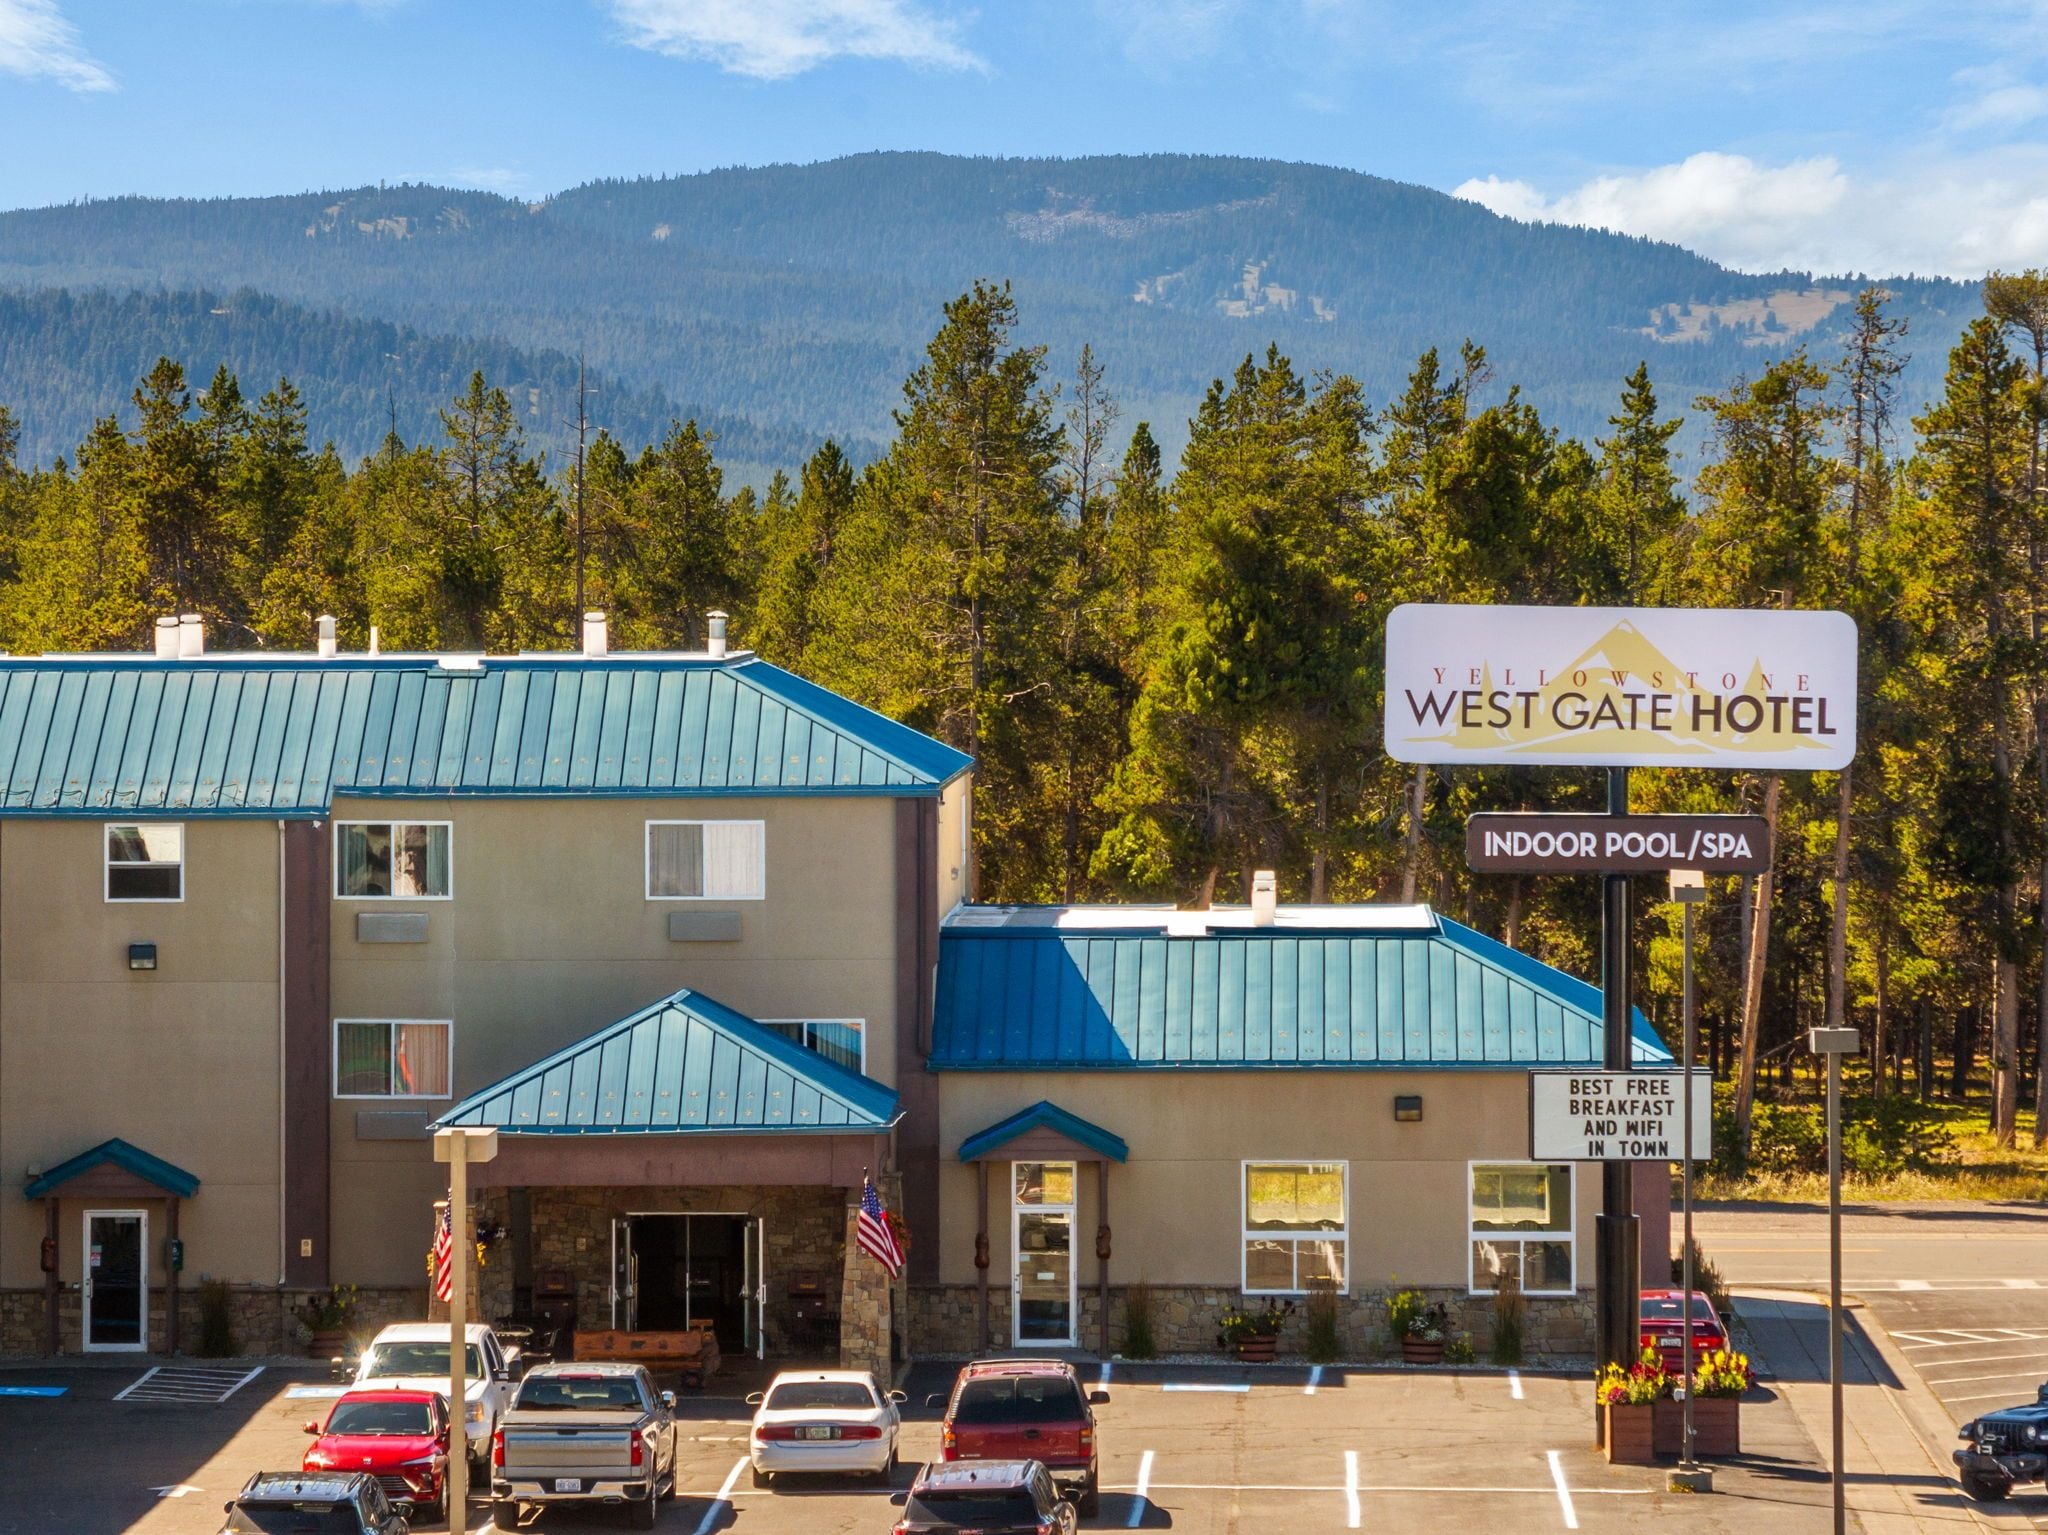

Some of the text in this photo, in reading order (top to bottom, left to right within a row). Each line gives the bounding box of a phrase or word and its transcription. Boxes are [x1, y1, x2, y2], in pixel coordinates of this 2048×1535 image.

[1433, 667, 1809, 691] YELLOWSTONE
[1404, 689, 1837, 735] WEST GATE HOTEL
[1485, 830, 1753, 861] INDOOR POOL/SPA
[1569, 1079, 1670, 1096] BEST FREE
[1569, 1100, 1675, 1116] BREAKFAST
[1584, 1120, 1663, 1137] AND WIFI
[1588, 1140, 1669, 1157] IN TOWN
